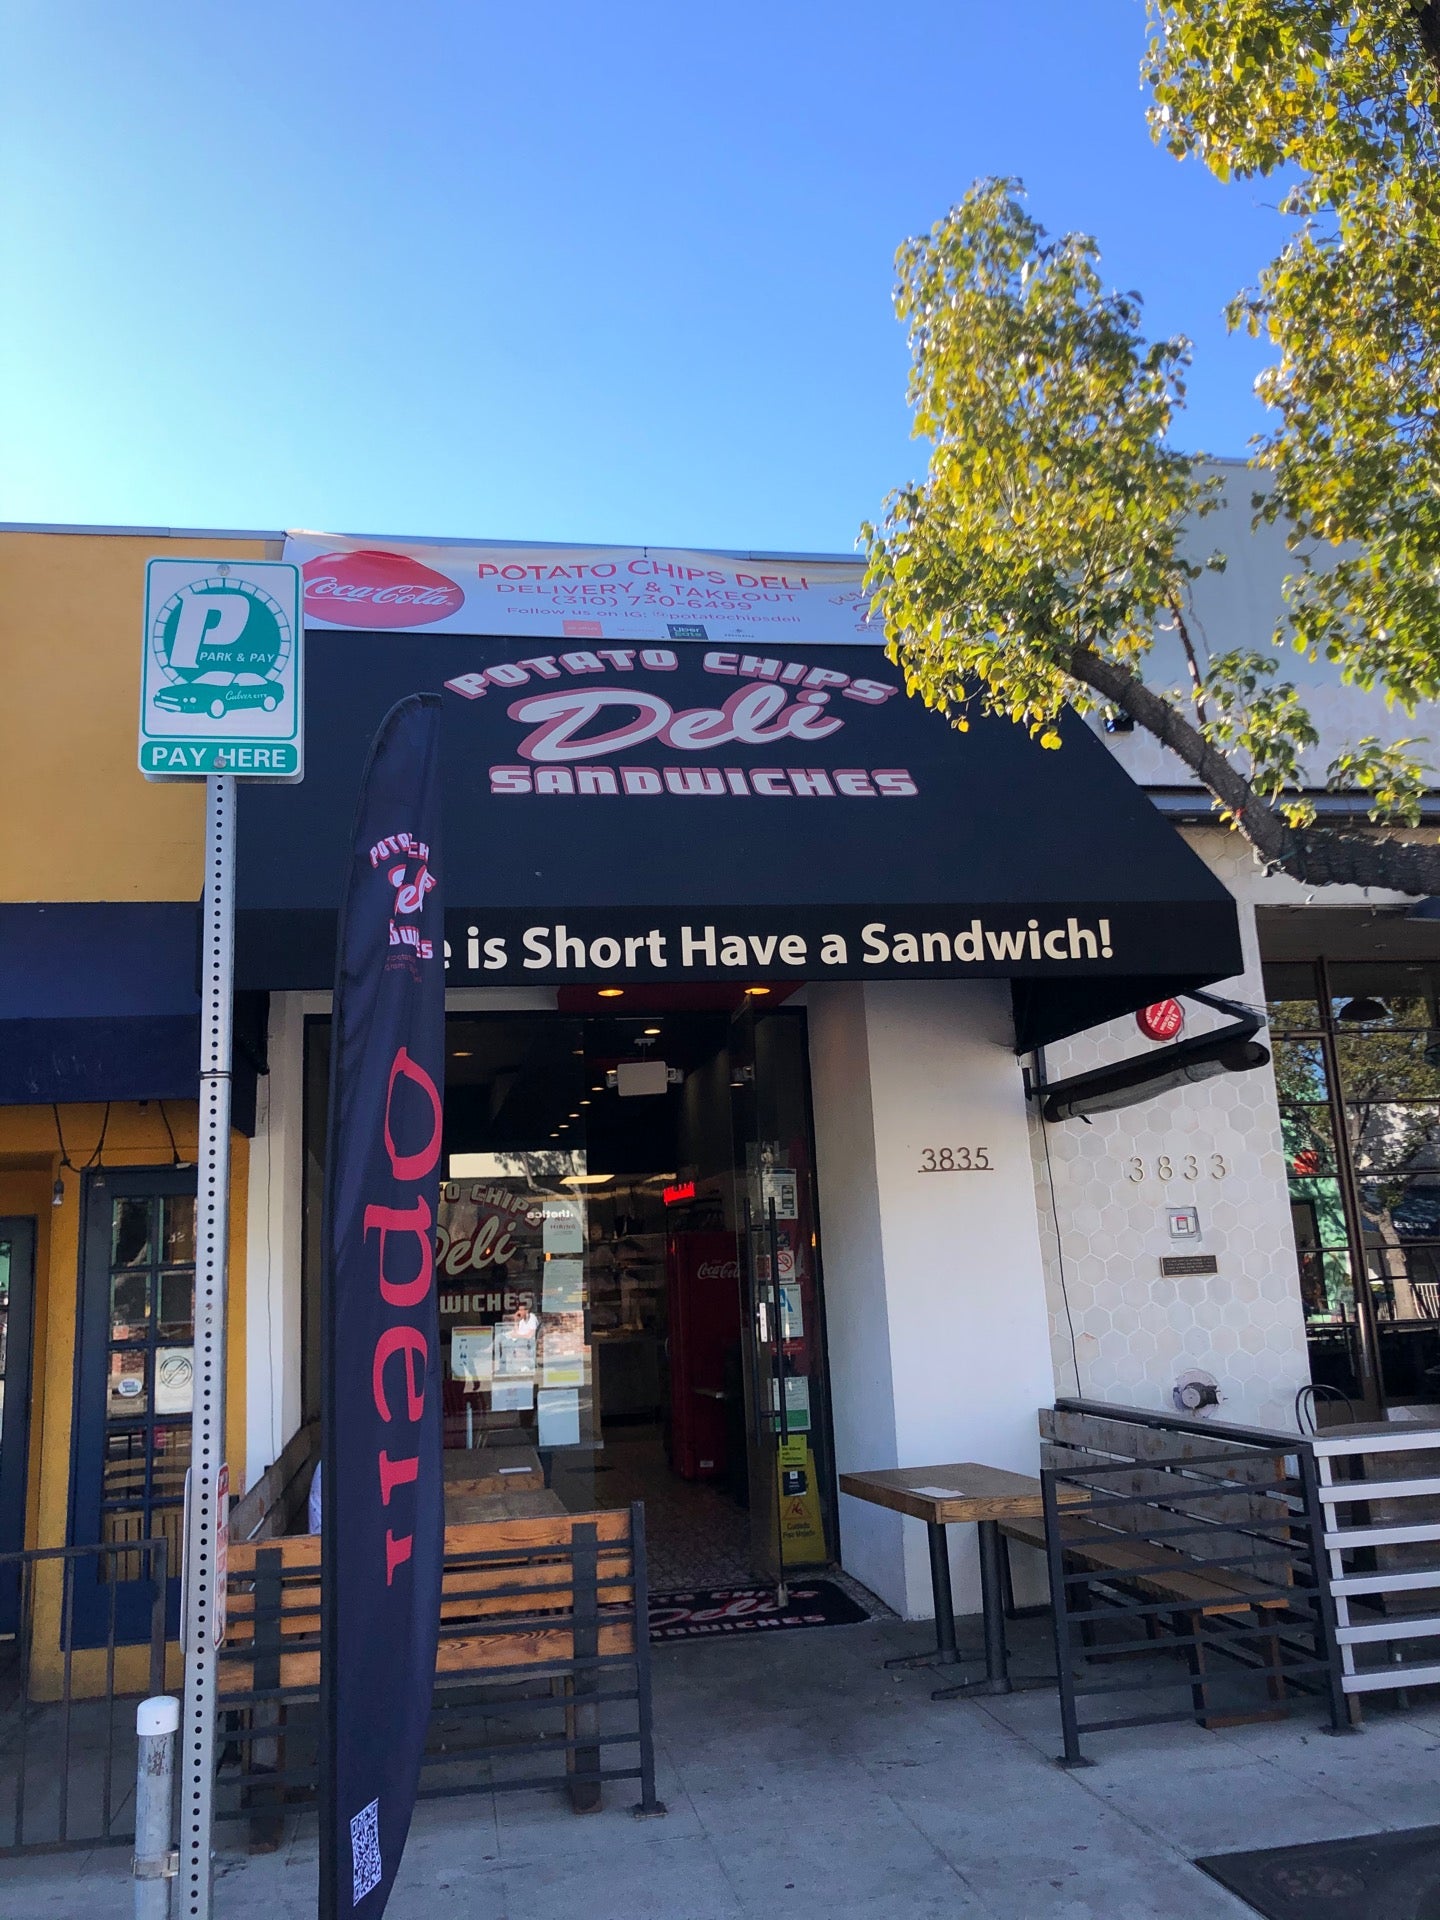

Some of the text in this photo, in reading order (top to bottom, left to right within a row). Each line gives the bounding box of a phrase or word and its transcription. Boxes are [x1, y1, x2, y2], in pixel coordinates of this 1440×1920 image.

[478, 560, 810, 591] POTATO CHIPS DELI
[496, 582, 796, 603] DELIVERY & TAKEOUT
[551, 594, 752, 611] (310) 730-6499
[200, 651, 275, 663] PARK & PAY
[444, 649, 898, 705] POTATO CHIPS
[507, 681, 845, 762] Deli
[152, 746, 287, 769] PAY HERE
[488, 766, 918, 797] SANDWICHES
[467, 925, 508, 970] is
[522, 925, 667, 970] Short
[681, 925, 808, 967] Have
[820, 933, 848, 965] a
[861, 917, 1114, 964] Sandwich!
[921, 1147, 989, 1170] 3835
[1128, 1154, 1228, 1183] 3833
[436, 1214, 518, 1276] eli
[439, 1291, 534, 1314] WICHES
